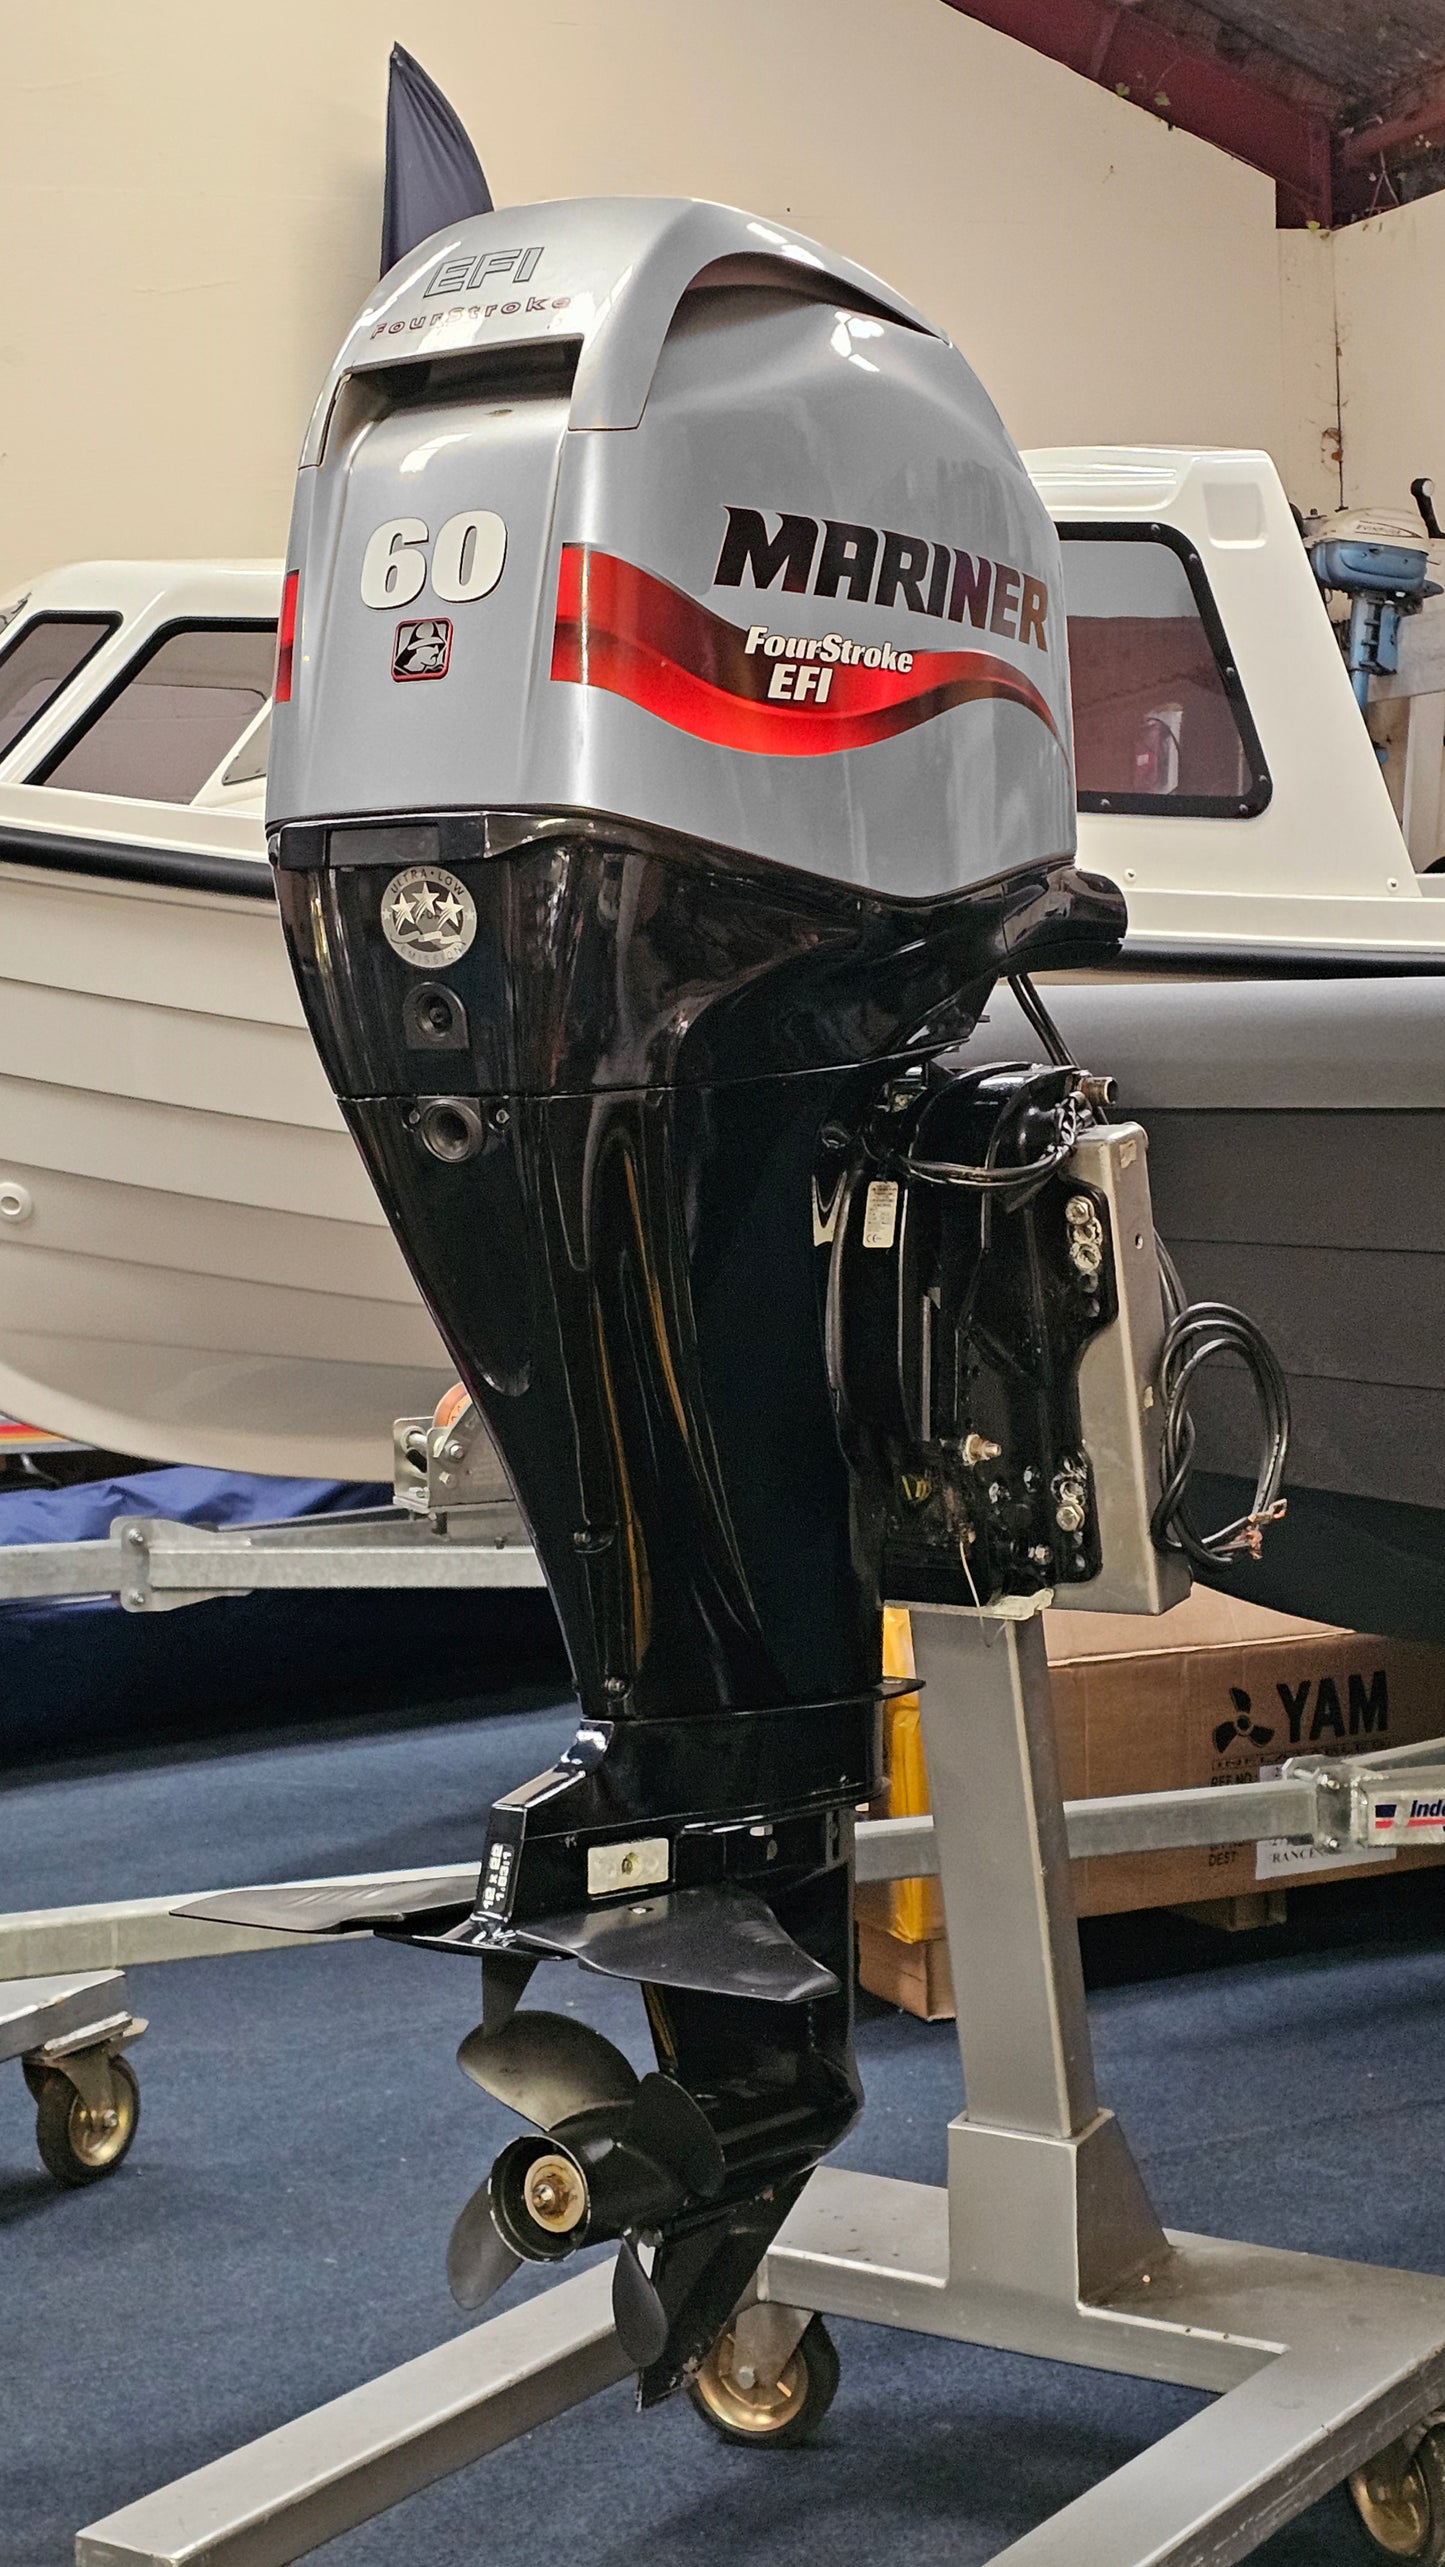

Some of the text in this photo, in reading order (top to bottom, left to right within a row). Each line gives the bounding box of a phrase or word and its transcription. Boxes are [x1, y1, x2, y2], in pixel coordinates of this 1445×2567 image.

[423, 247, 545, 299] EFI
[370, 297, 572, 340] FourStroke
[359, 509, 508, 611] 60
[713, 505, 1048, 652] MARINER
[744, 625, 914, 674] FourStroke
[767, 663, 834, 704] EFI
[391, 868, 465, 896] ULTRA LOW
[1276, 1670, 1389, 1743] YAM
